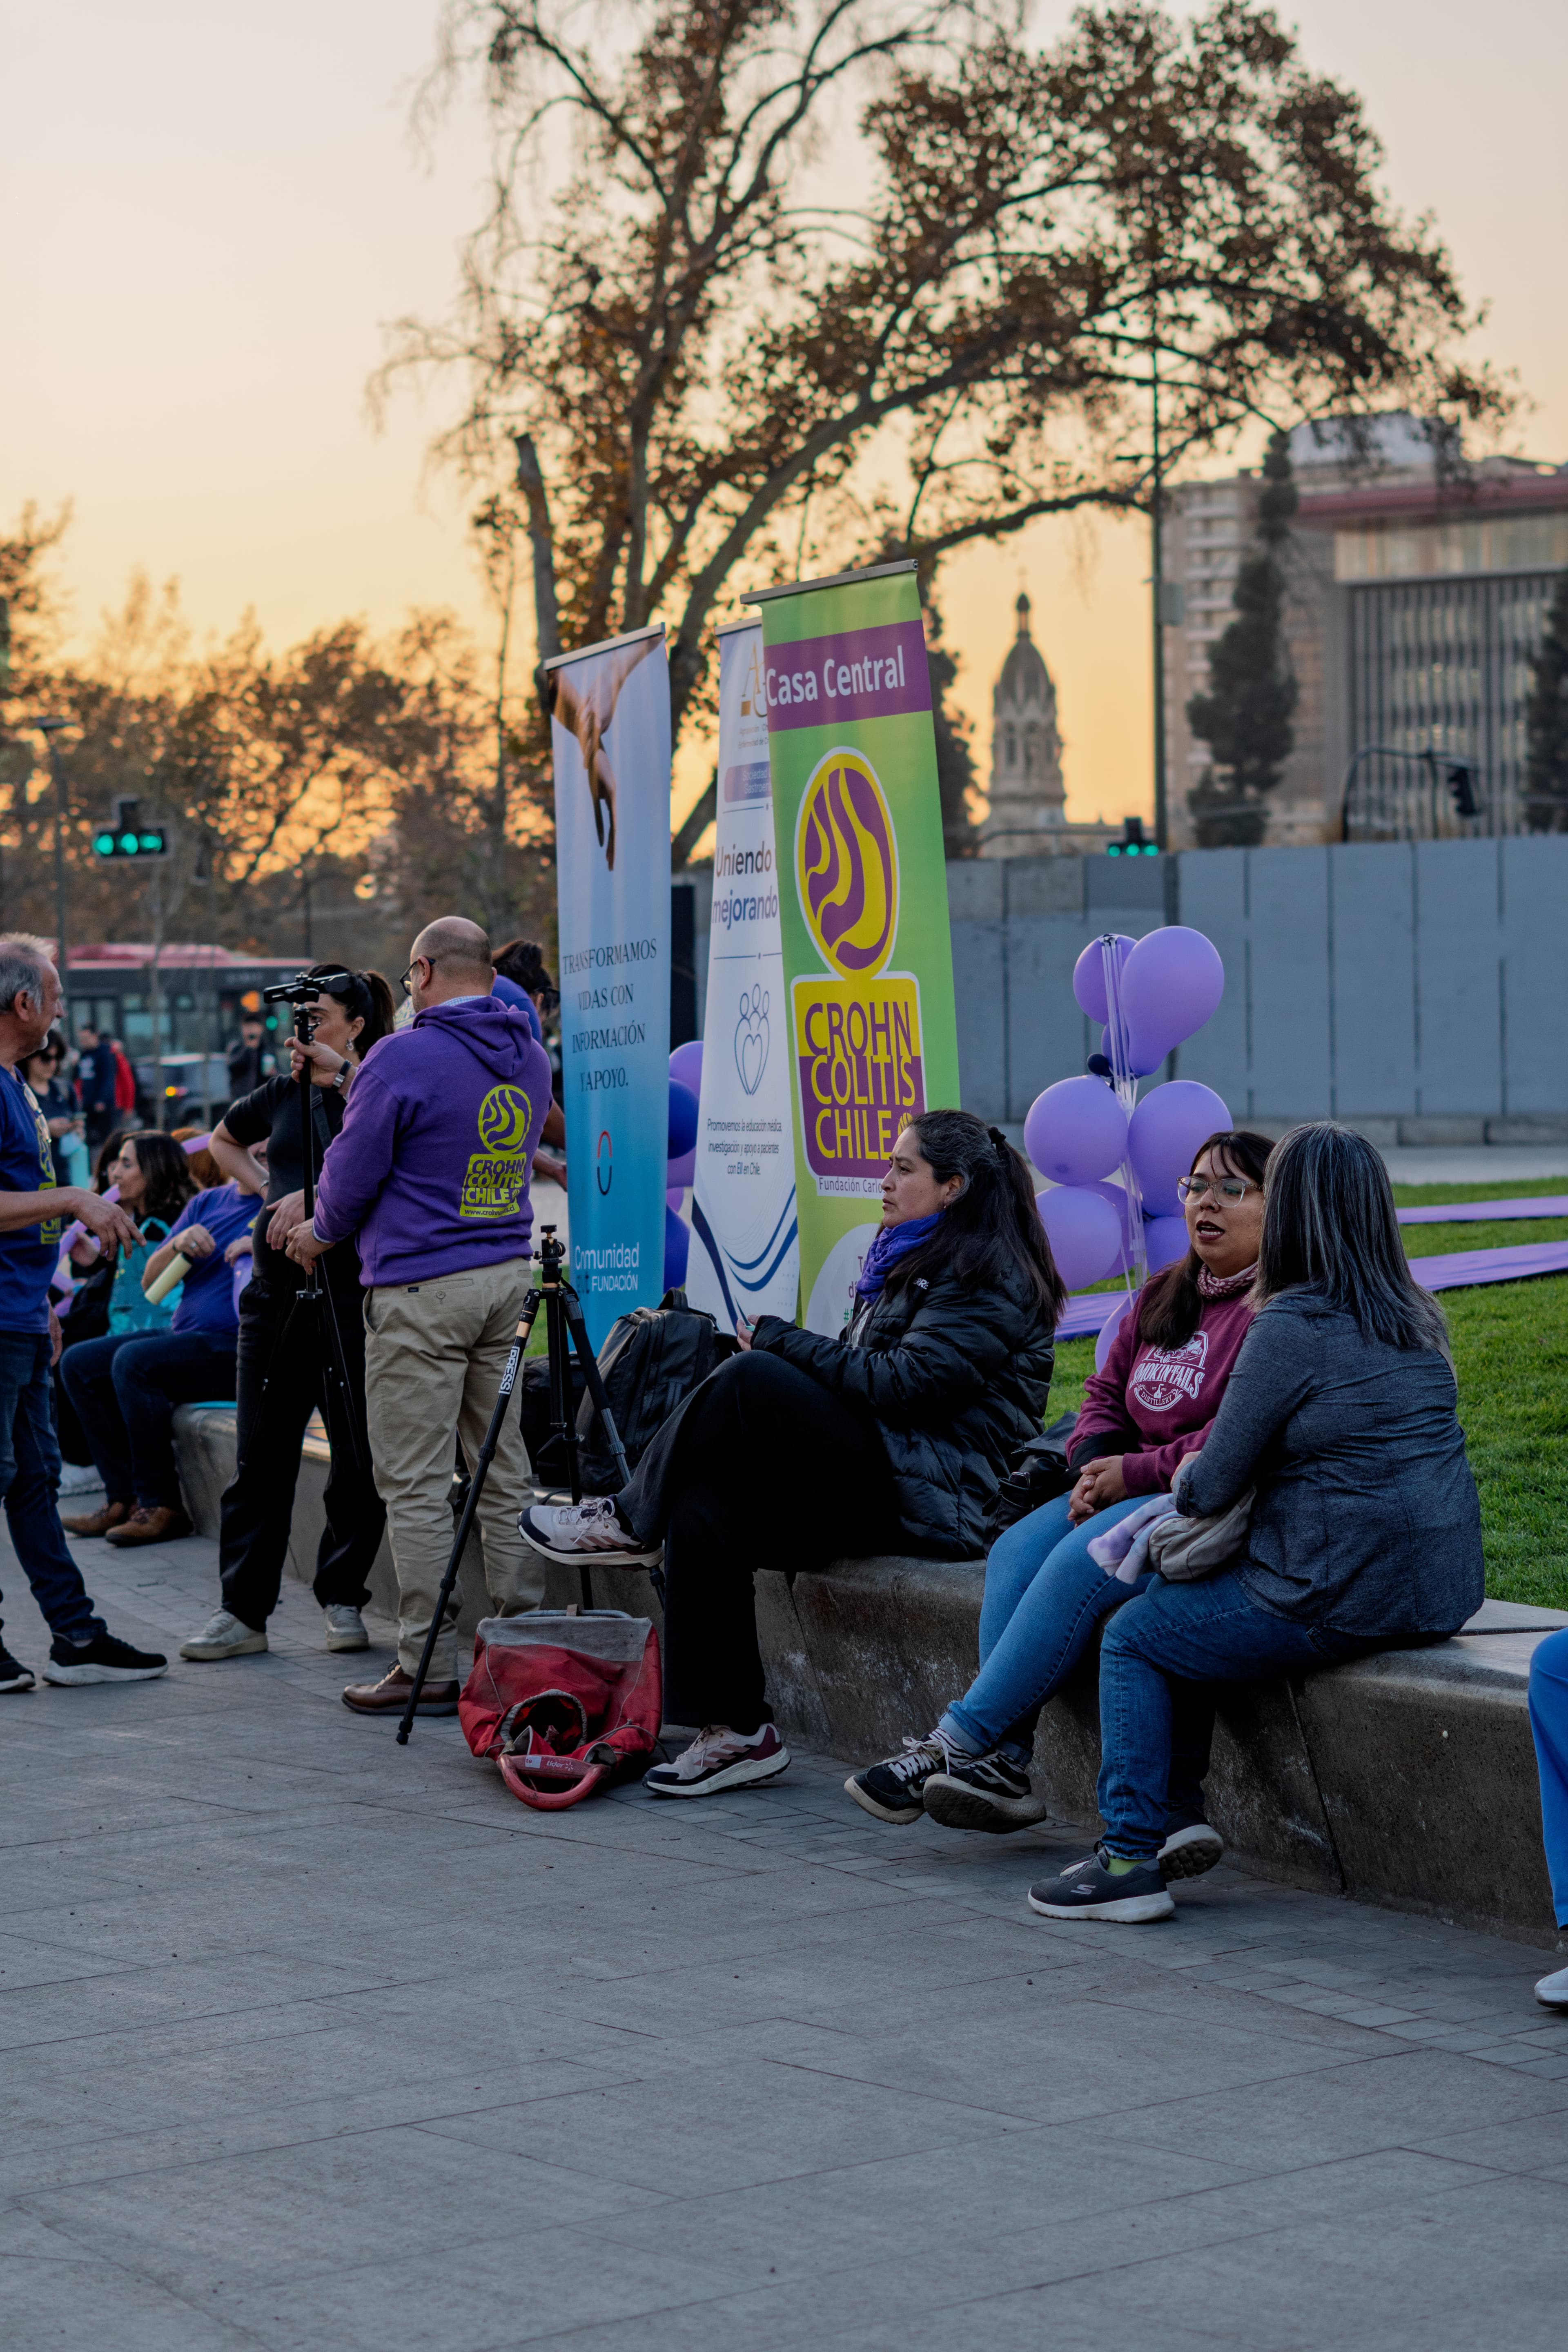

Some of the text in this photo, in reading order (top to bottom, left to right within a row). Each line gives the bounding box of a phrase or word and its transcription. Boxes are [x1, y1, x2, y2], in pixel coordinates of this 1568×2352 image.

[766, 645, 905, 706] Casa Central
[716, 841, 771, 877] Uniendo
[712, 885, 778, 930] mejorando
[563, 938, 657, 975] TRANSFORMAMOS
[578, 984, 633, 1011] VIDAS CON
[572, 1020, 645, 1053] INFORMACIÓN
[804, 1001, 912, 1057] CROHN
[811, 1054, 915, 1107] COLITIS
[708, 1118, 740, 1131] Promovemos
[742, 1118, 745, 1131] la
[746, 1118, 766, 1131] educación
[815, 1109, 892, 1160] CHILE
[708, 1140, 779, 1156] investigación y apoyo a pacientes
[472, 1158, 525, 1174] CROHN
[728, 1165, 736, 1174] con
[744, 1165, 749, 1174] en
[750, 1162, 761, 1175] Chile.
[468, 1172, 523, 1189] COLITIS
[819, 1177, 885, 1193] Fundación Carlo
[466, 1187, 510, 1204] CHILE
[592, 1270, 638, 1292] FUNDACIÓN
[500, 1349, 517, 1391] PRESS
[1141, 1391, 1172, 1405] DISTILLERY
